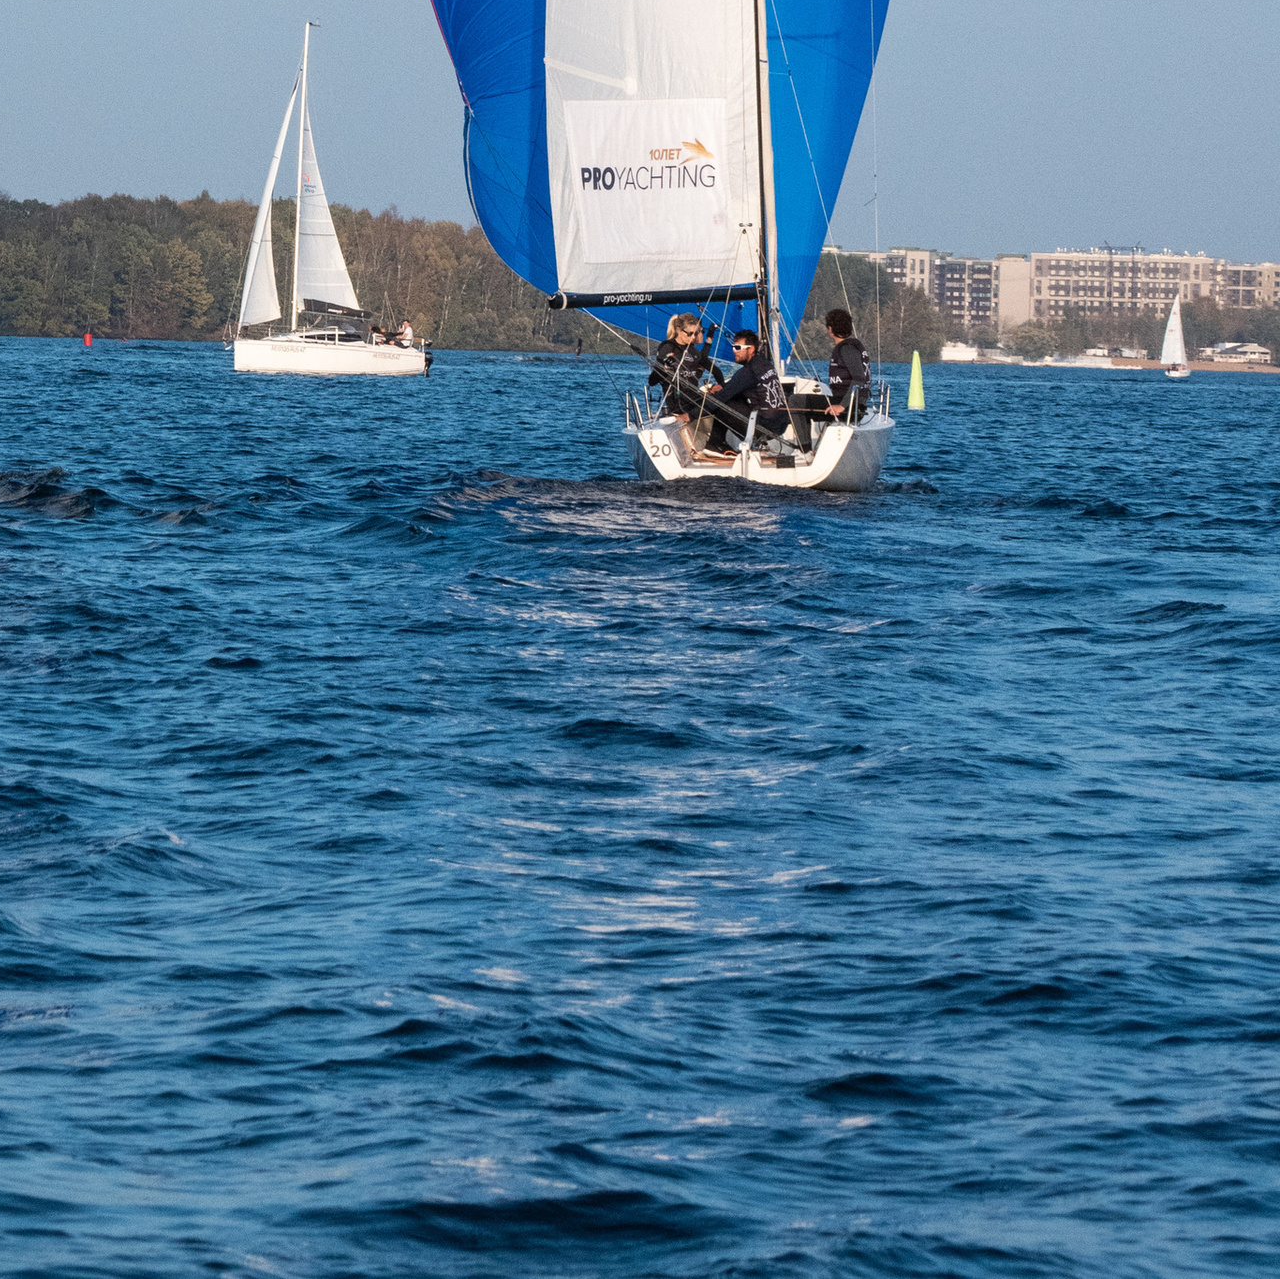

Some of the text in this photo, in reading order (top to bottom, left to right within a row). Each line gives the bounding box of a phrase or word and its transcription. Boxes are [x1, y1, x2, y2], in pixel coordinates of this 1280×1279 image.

[581, 164, 716, 190] PROYACHTING
[603, 292, 653, 305] pro-yachting.ru
[650, 443, 671, 457] 20
